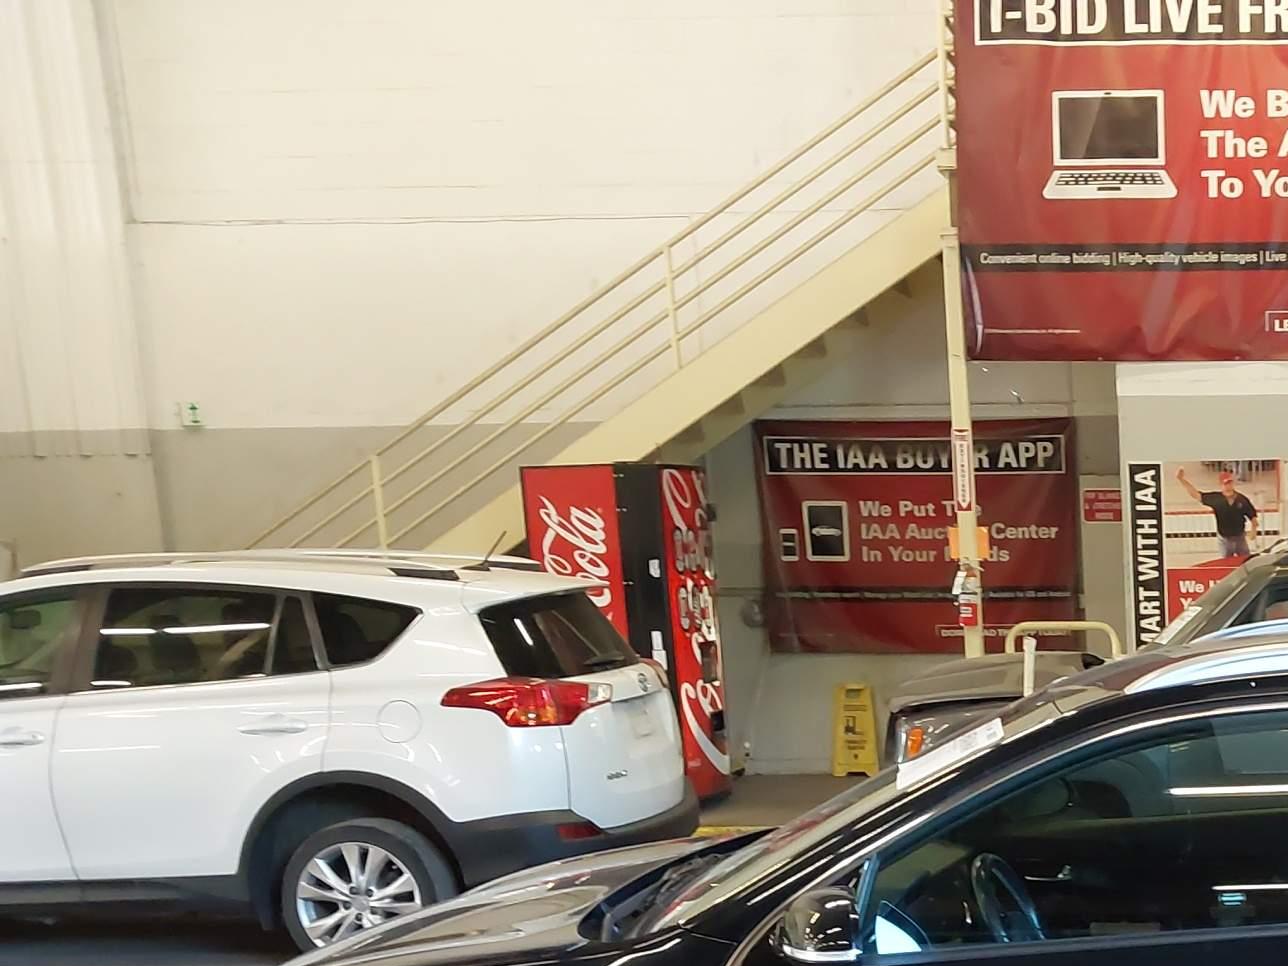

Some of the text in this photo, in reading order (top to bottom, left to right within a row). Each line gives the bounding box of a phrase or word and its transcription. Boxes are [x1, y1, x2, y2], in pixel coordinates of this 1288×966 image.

[1124, 0, 1224, 34] LIVE
[1199, 89, 1256, 119] We
[1200, 130, 1269, 158] The
[1200, 170, 1244, 199] To
[980, 252, 1037, 265] Convenient
[1039, 252, 1071, 264] online
[1072, 252, 1111, 266] bidding
[1118, 251, 1181, 266] High-quality
[1182, 251, 1219, 264] vehicle
[1220, 251, 1258, 265] images
[1265, 250, 1287, 262] Live
[775, 441, 1055, 470] THE IAA BUYR APP
[1133, 469, 1158, 512] IAA
[858, 500, 983, 518] We Put Te
[860, 524, 901, 540] IAA
[990, 522, 1059, 540] Center
[861, 545, 882, 563] In
[888, 545, 937, 563] Your
[1135, 518, 1161, 582] WITH
[1178, 580, 1206, 594] We
